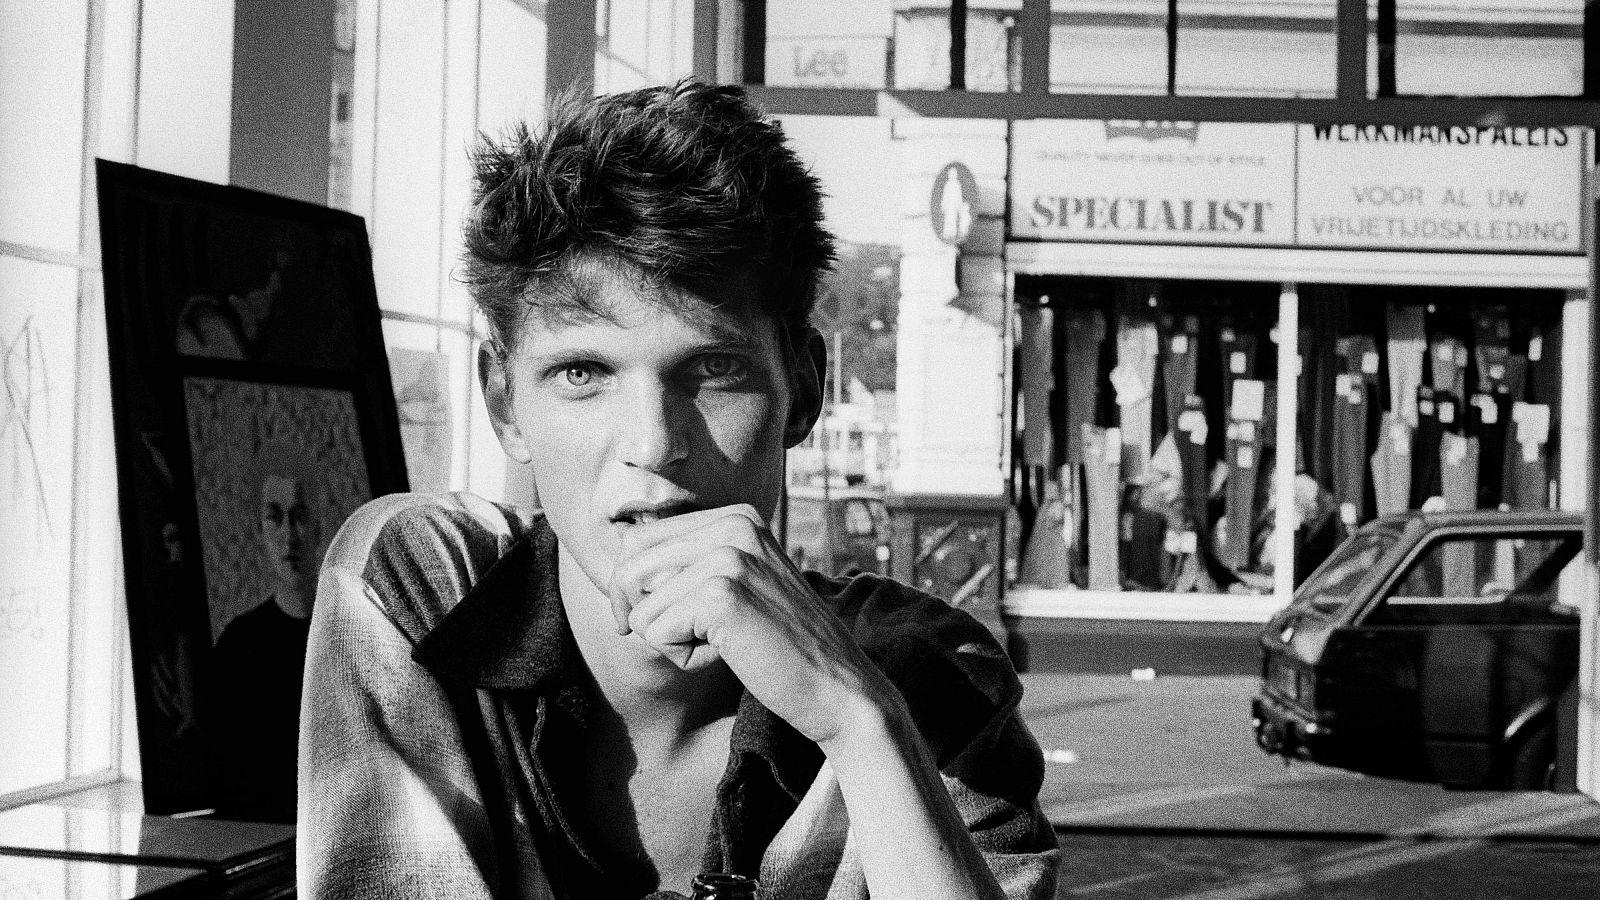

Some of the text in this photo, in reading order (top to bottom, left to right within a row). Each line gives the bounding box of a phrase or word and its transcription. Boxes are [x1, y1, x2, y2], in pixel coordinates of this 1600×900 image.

[792, 46, 849, 78] Lee
[1352, 185, 1528, 209] VOOR AL UW
[1030, 196, 1274, 234] SPECIALIST
[1311, 216, 1569, 242] VRIJETIJDSKLEDING
